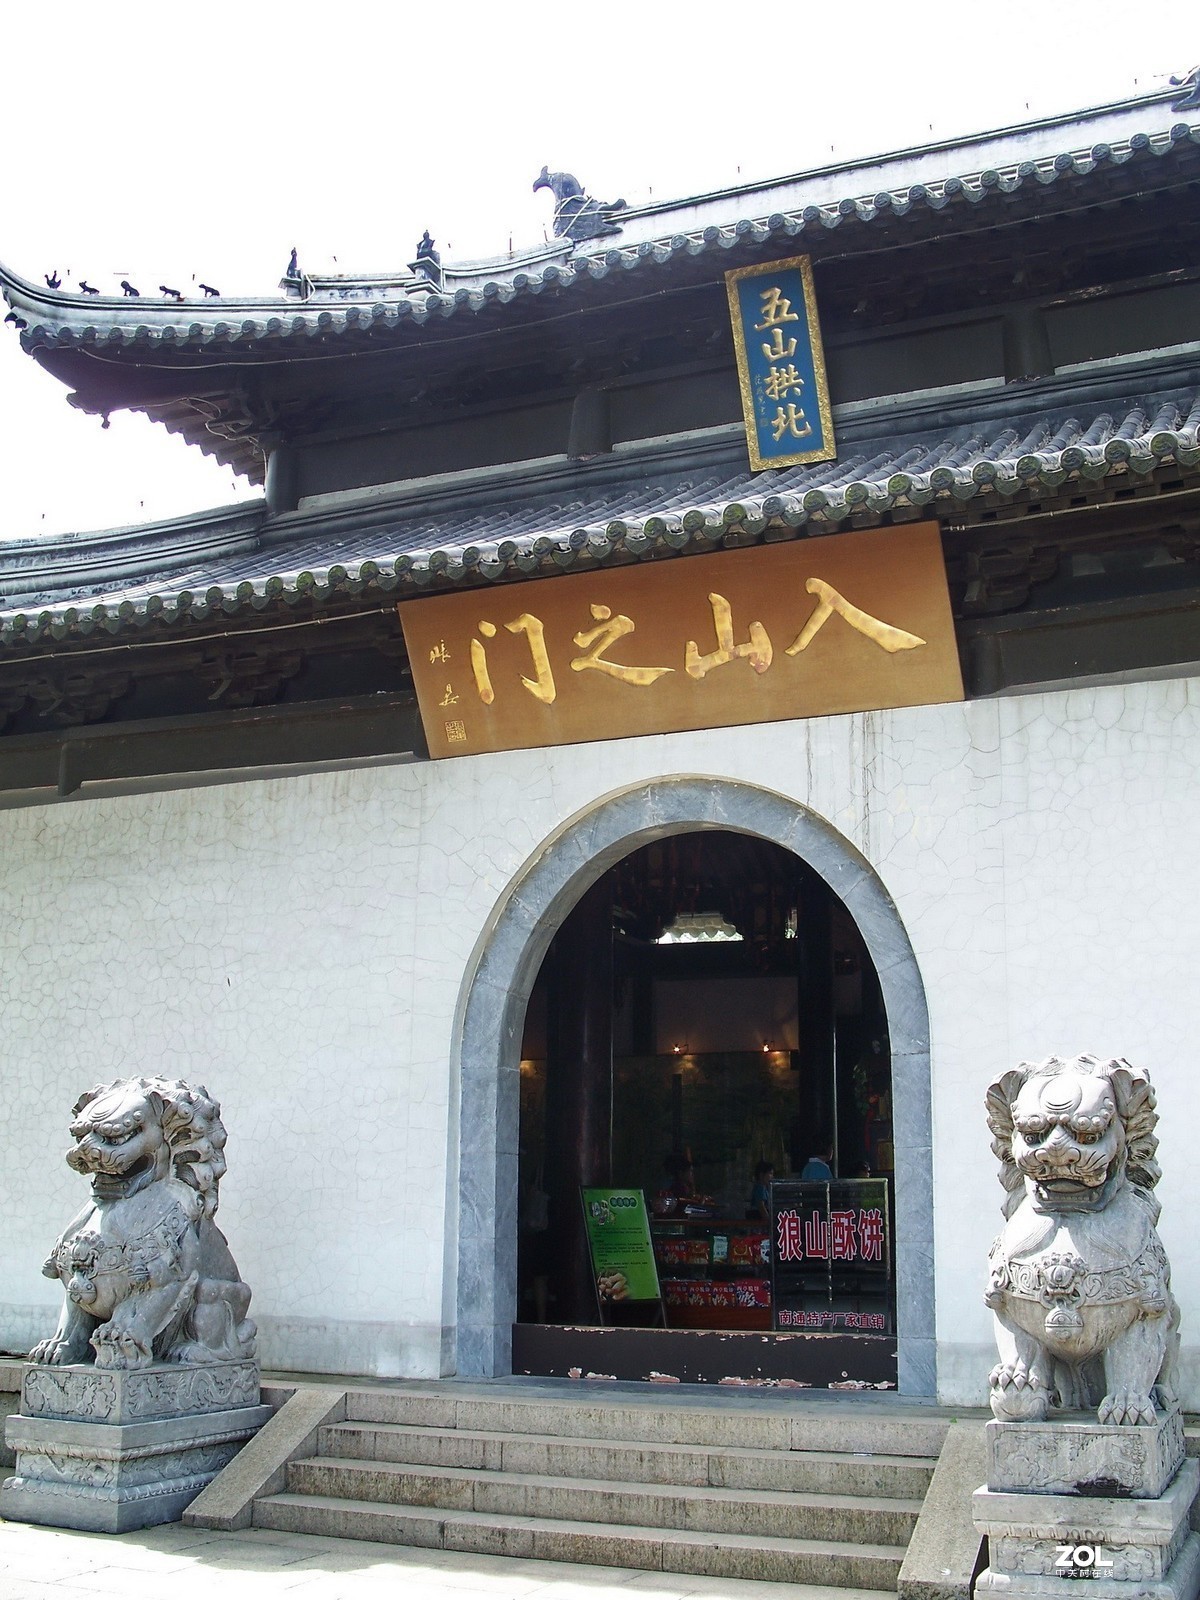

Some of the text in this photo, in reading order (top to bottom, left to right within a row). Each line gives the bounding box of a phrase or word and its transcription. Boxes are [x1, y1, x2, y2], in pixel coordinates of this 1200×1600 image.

[754, 286, 813, 442] 五山拱北
[777, 1208, 884, 1261] 狼山酥饼
[779, 1309, 885, 1329] 南通特产厂家直销
